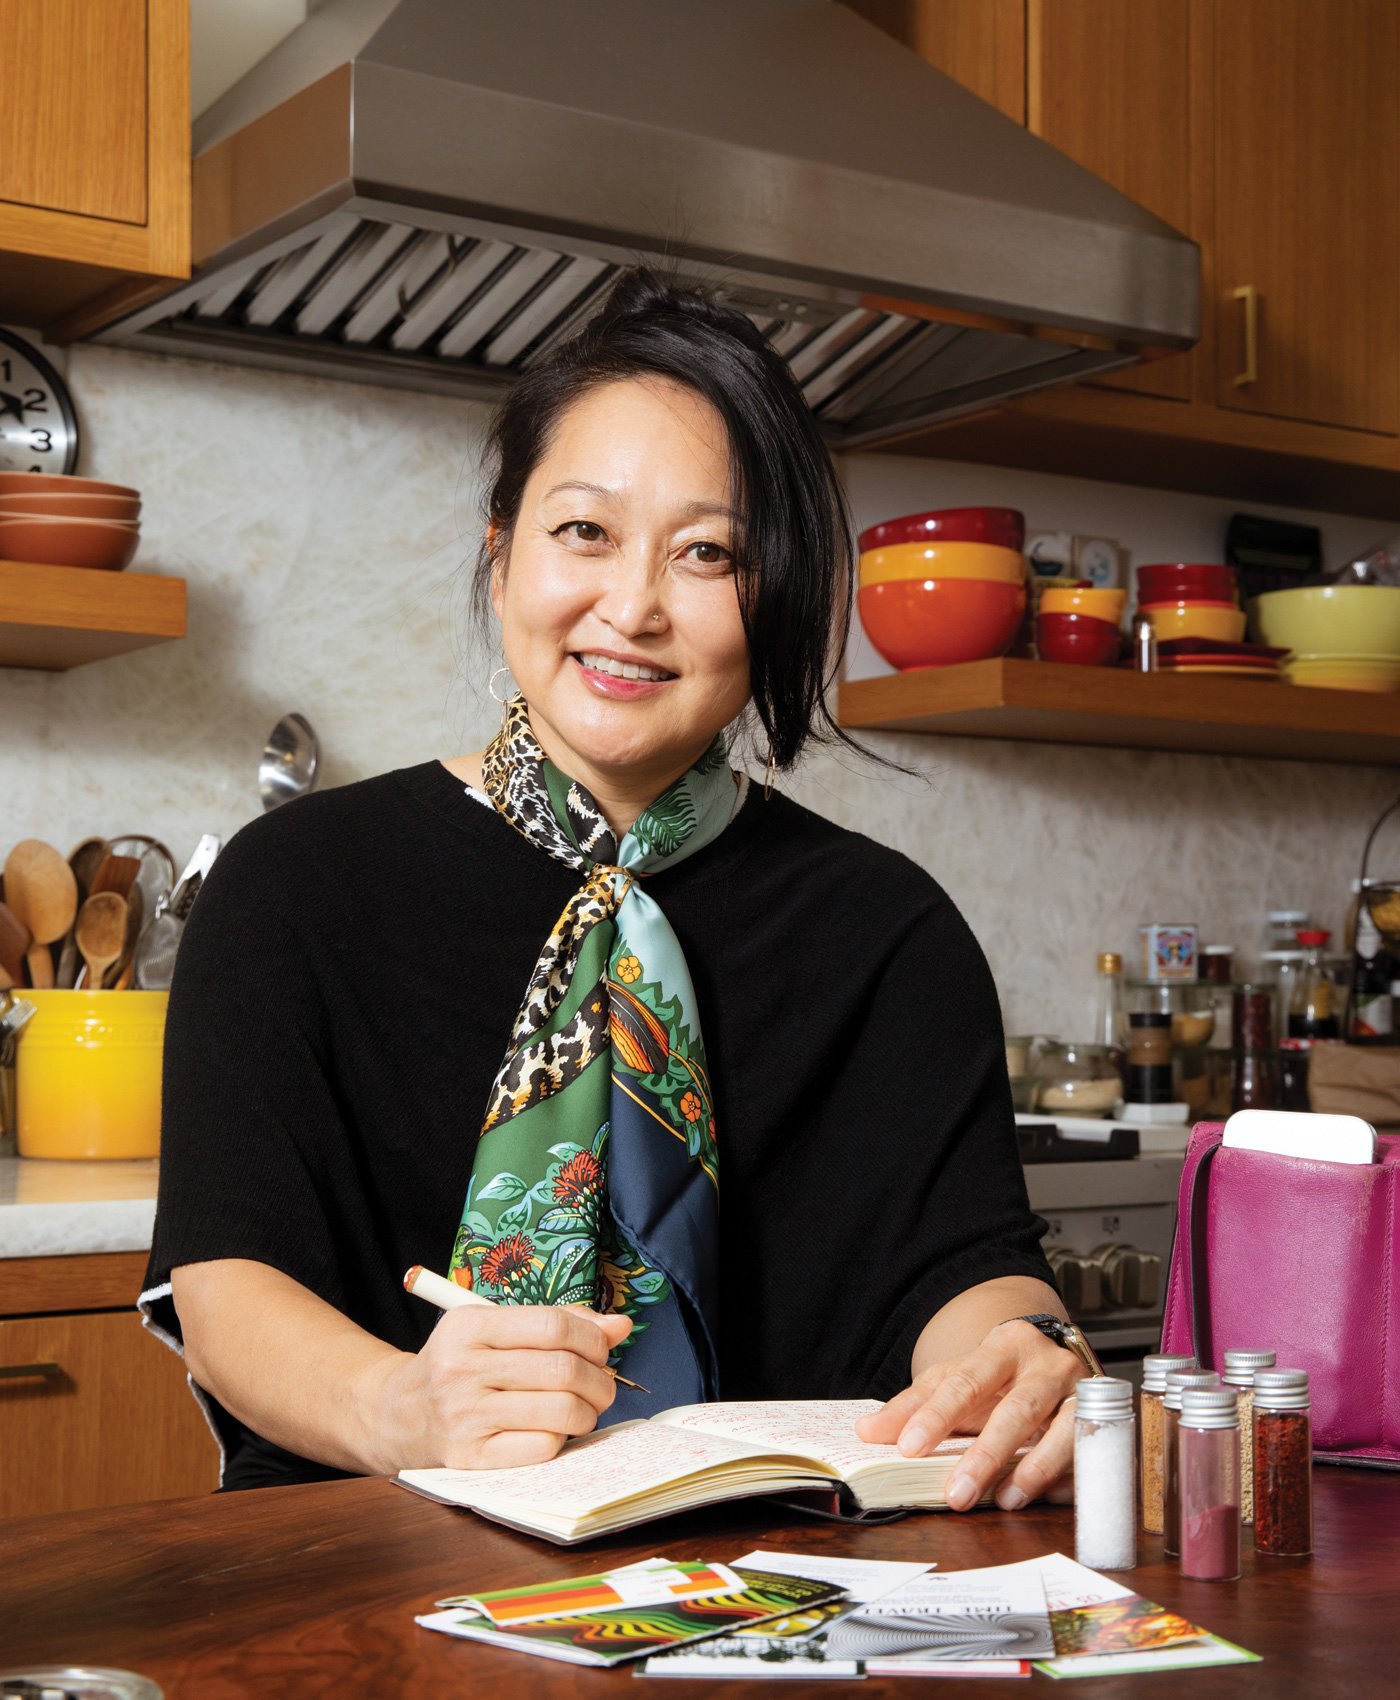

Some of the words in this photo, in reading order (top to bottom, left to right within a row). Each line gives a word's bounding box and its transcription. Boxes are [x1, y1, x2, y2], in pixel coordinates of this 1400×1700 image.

[1, 359, 12, 382] 1
[23, 389, 47, 412] 2
[30, 429, 52, 452] 3
